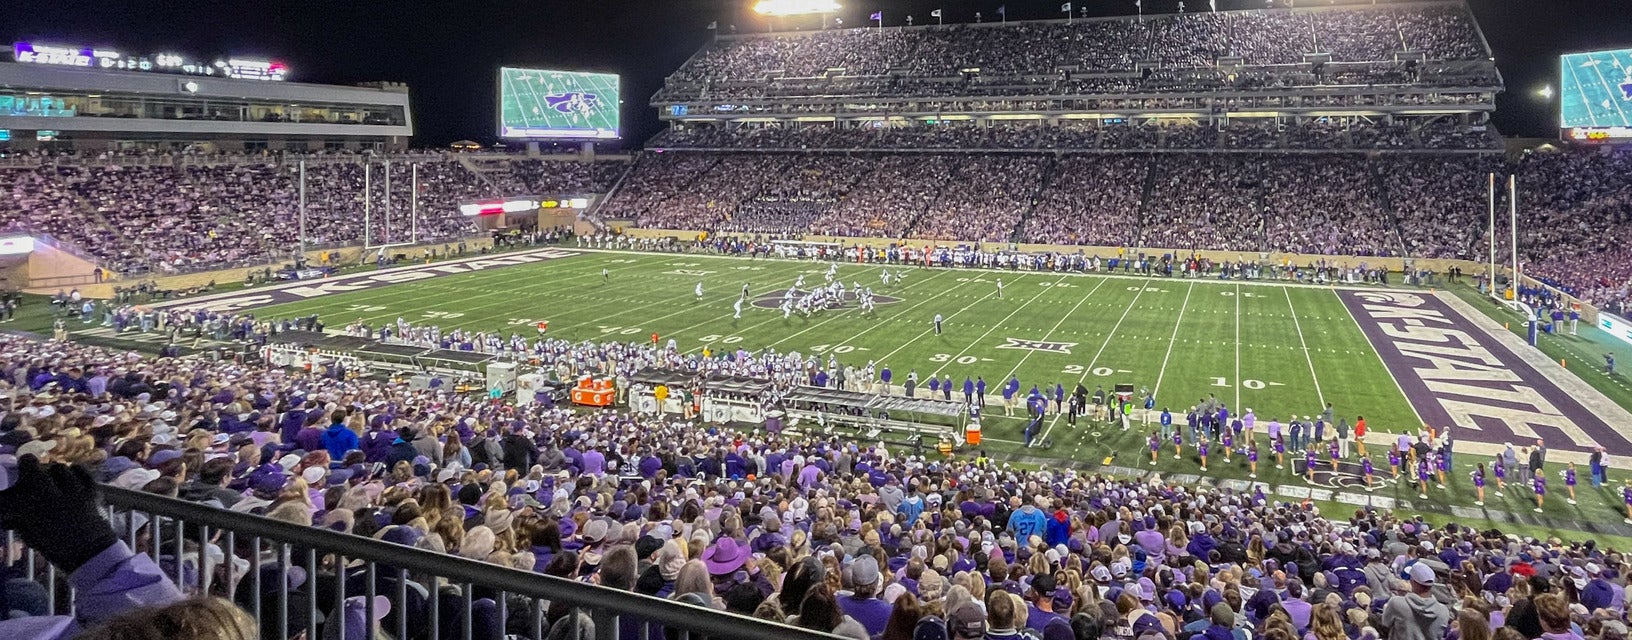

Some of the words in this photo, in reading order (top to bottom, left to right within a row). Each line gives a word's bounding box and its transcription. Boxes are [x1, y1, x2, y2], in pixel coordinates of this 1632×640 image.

[282, 249, 581, 298] K-STATE
[699, 334, 743, 344] 50
[810, 344, 855, 354] 40
[929, 353, 977, 365] 30
[1061, 364, 1114, 377] 20
[1361, 303, 1601, 449] K-STATE
[1210, 376, 1266, 390] 10
[1019, 521, 1036, 535] 27
